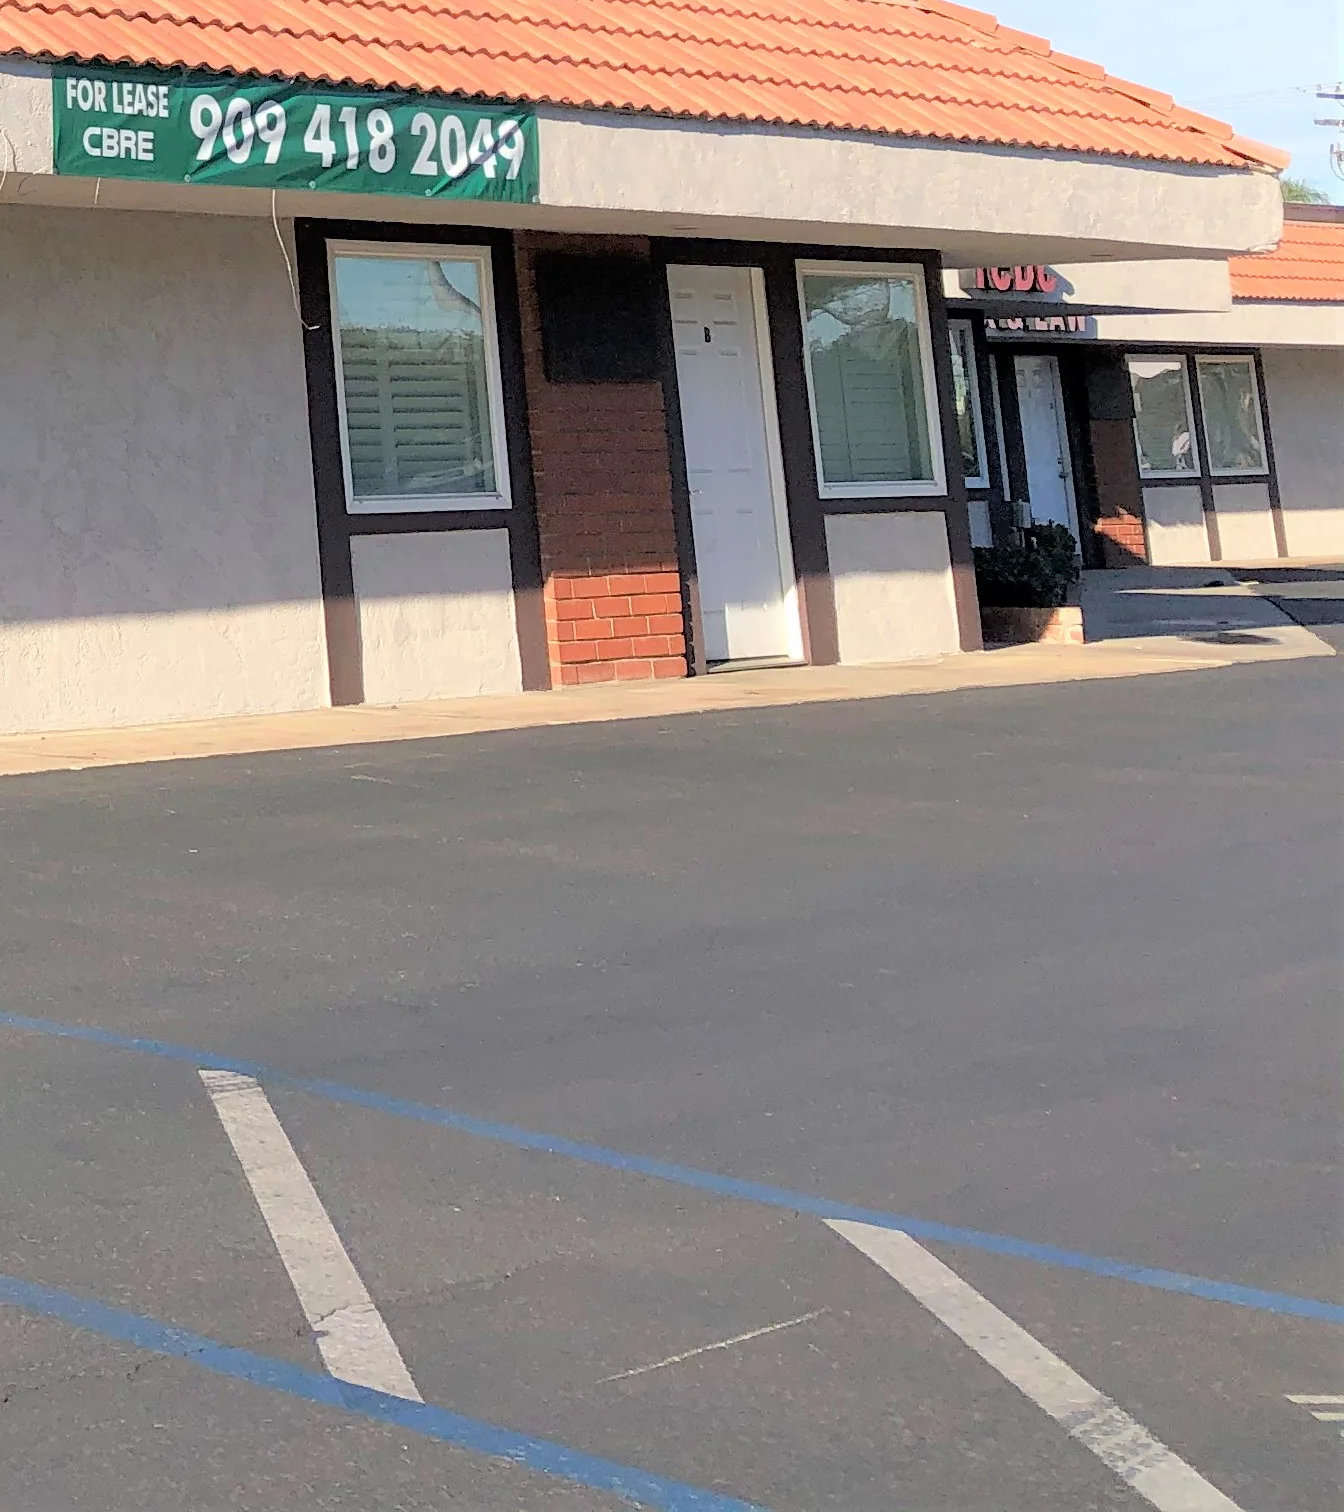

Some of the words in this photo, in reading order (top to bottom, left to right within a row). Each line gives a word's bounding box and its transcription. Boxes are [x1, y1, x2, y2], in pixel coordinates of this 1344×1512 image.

[66, 76, 107, 113] FOR
[112, 81, 170, 118] LEASE
[83, 126, 154, 162] CBRE
[190, 94, 286, 165] 909
[304, 104, 396, 174] 418
[410, 112, 525, 180] 2049
[703, 326, 712, 344] B
